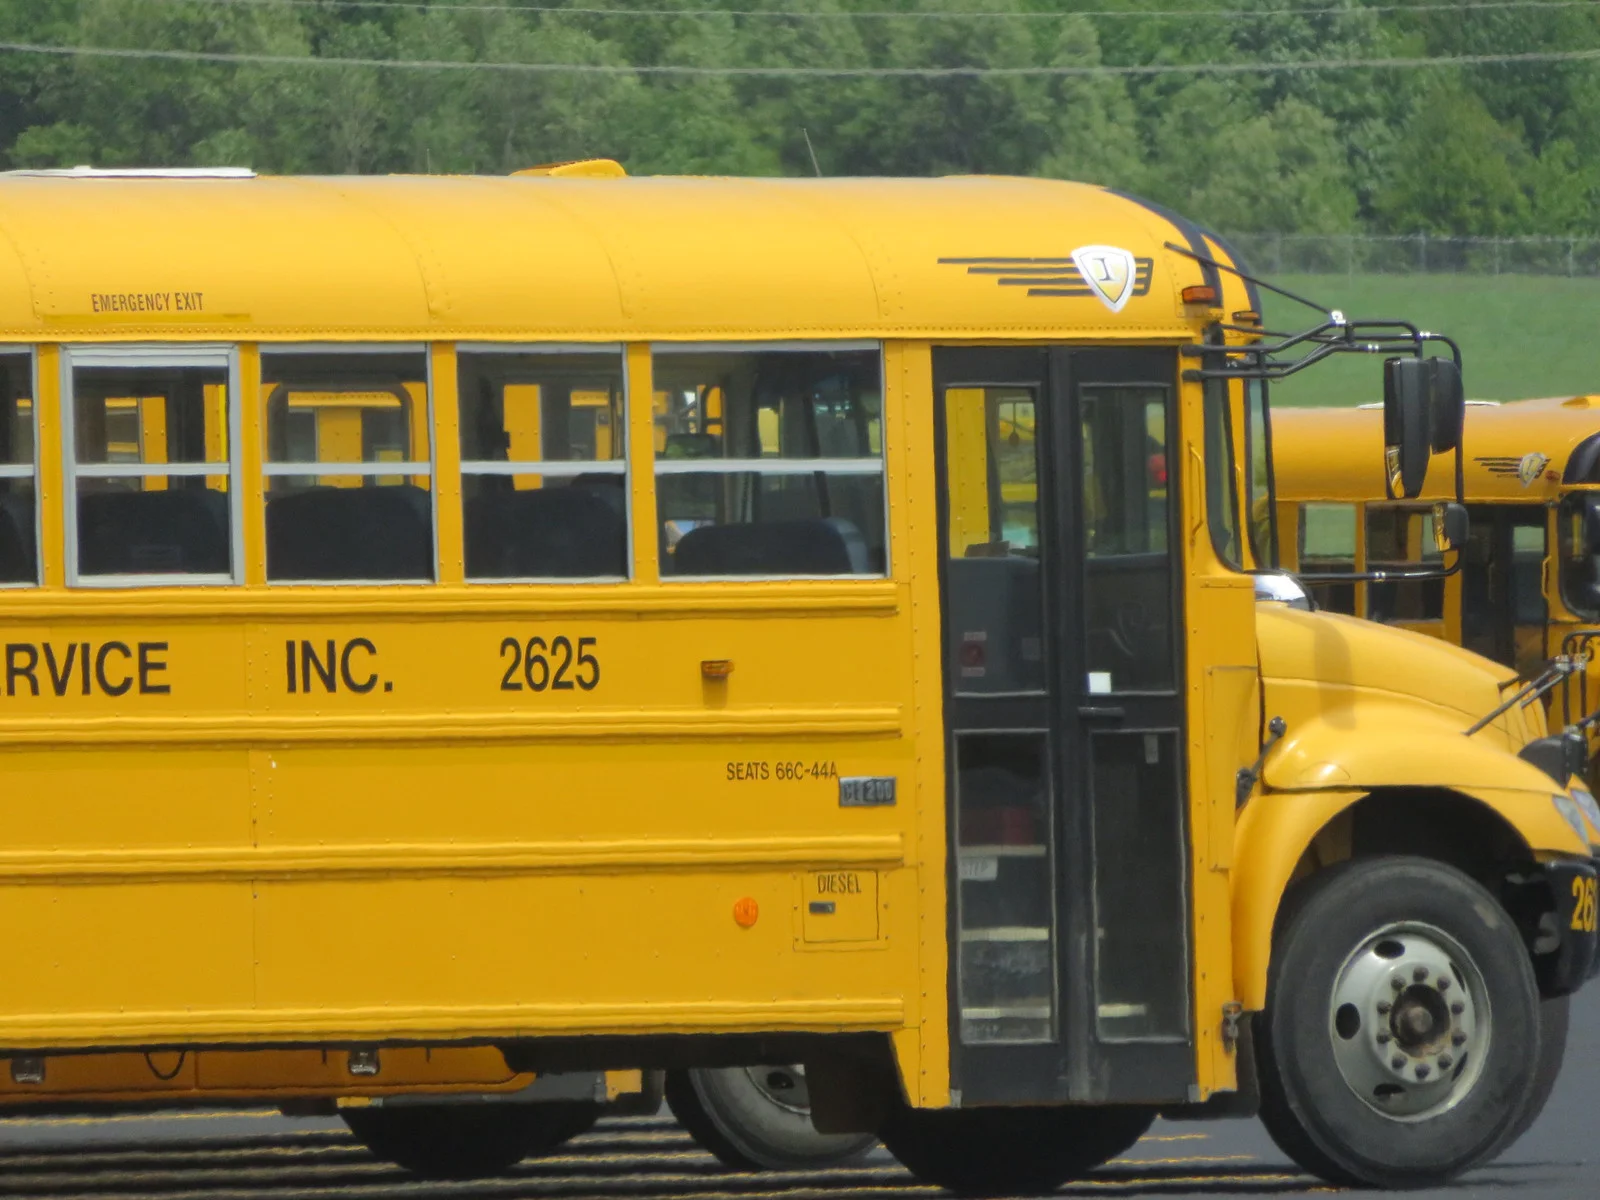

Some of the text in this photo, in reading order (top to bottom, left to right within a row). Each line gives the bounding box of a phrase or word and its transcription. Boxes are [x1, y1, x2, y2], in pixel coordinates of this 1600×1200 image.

[91, 292, 204, 313] EMERGENCY EXIT
[0, 637, 394, 697] RVICE INC.
[500, 635, 600, 692] 2625
[726, 761, 839, 781] SEATS 66C-44A
[817, 873, 862, 895] DIESEL
